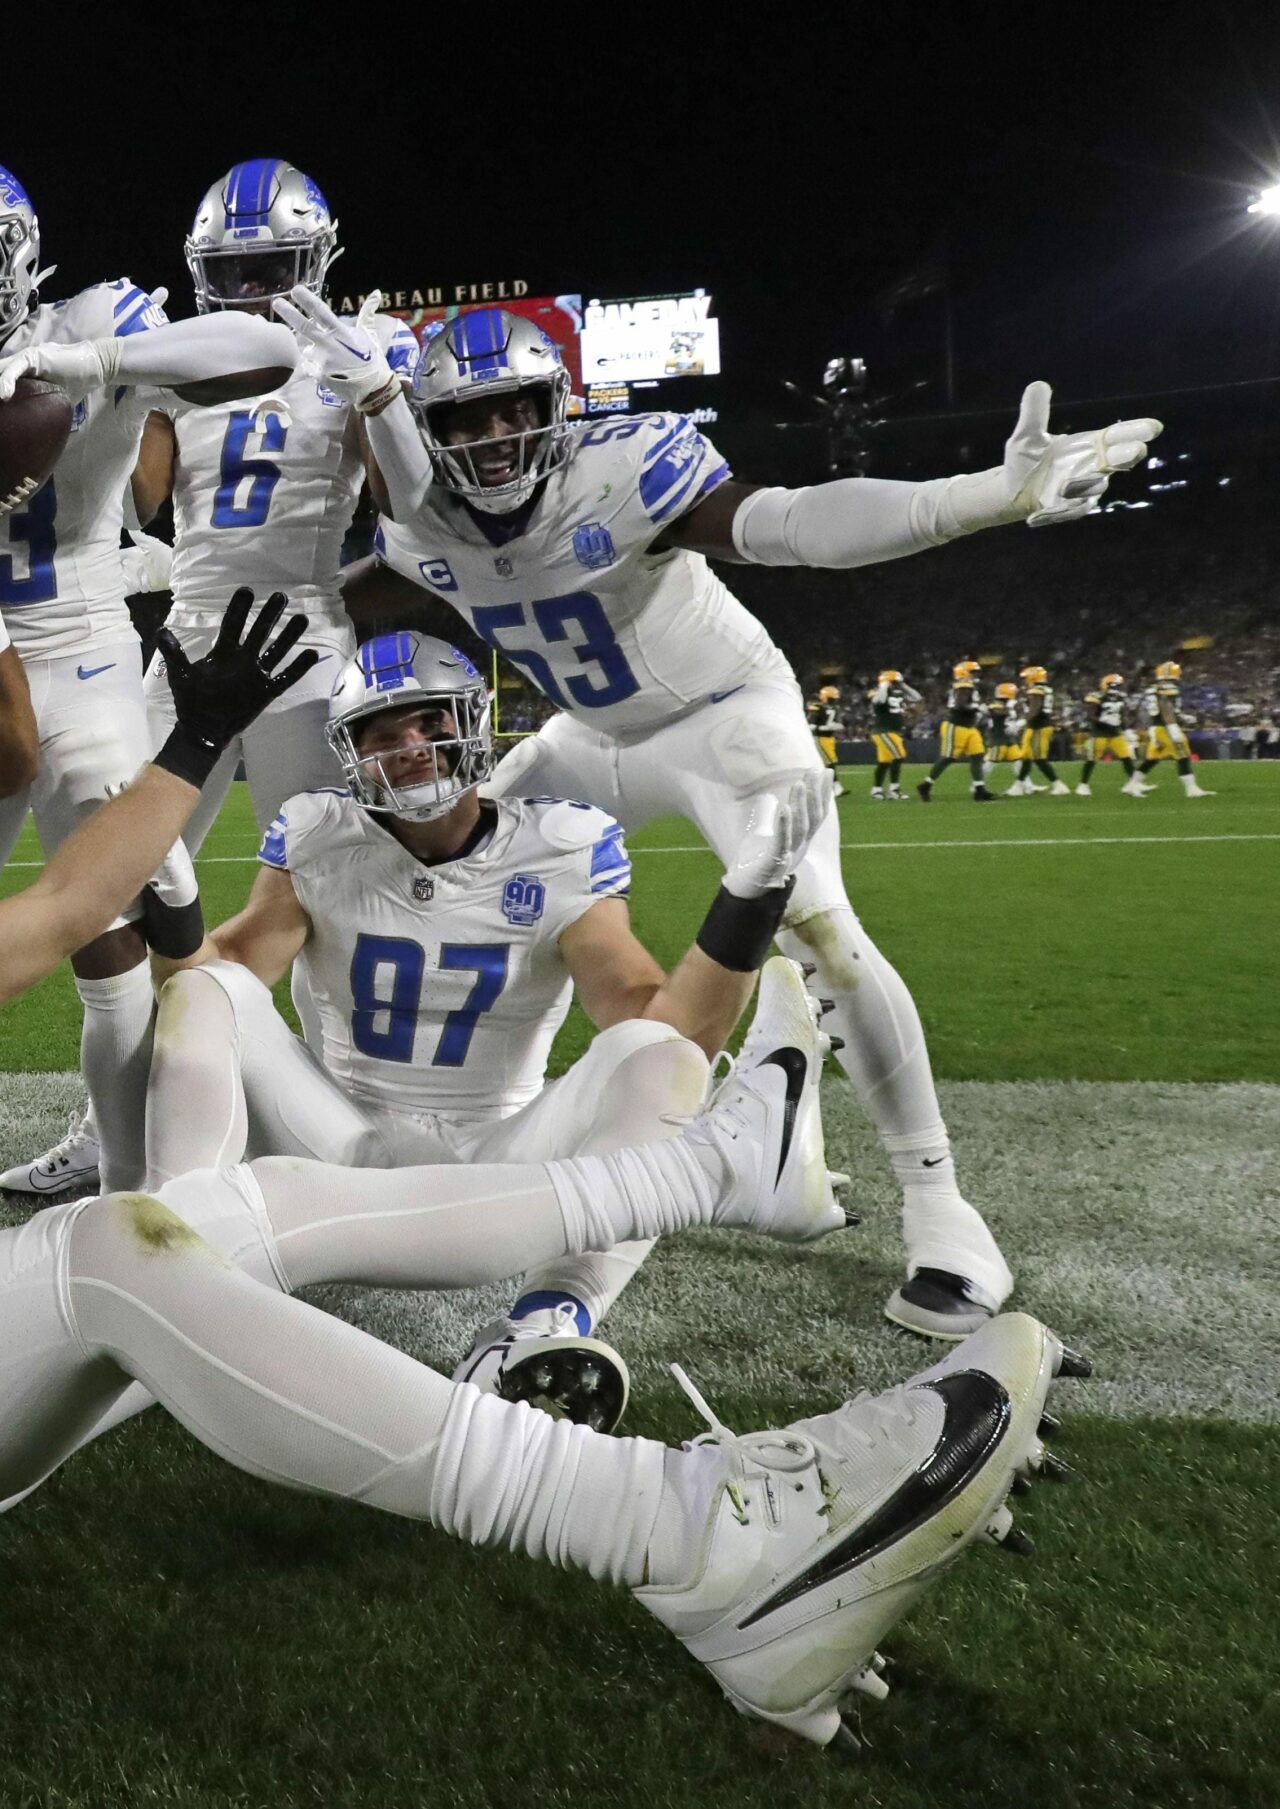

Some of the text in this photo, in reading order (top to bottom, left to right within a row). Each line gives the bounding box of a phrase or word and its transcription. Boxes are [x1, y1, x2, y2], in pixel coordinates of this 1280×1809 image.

[455, 280, 528, 302] FIELD
[588, 401, 630, 412] CANCER
[209, 410, 289, 529] 6
[423, 564, 451, 585] C
[471, 590, 642, 711] 53
[506, 881, 543, 913] 90
[350, 932, 510, 1067] 87
